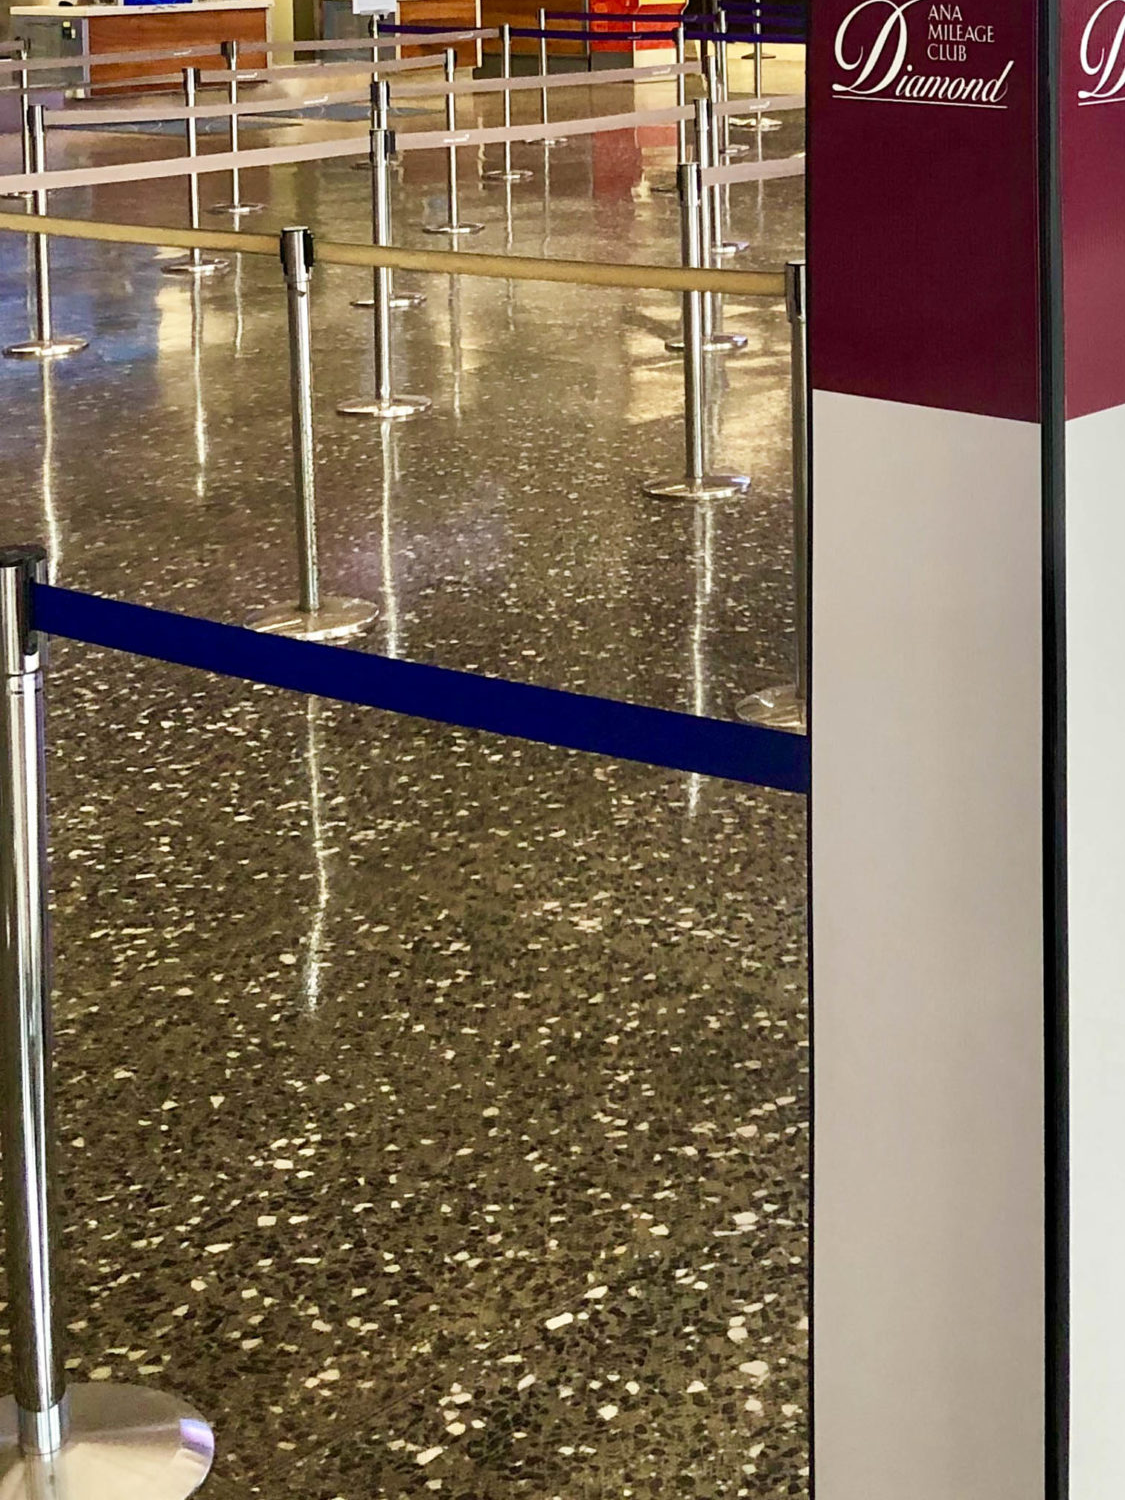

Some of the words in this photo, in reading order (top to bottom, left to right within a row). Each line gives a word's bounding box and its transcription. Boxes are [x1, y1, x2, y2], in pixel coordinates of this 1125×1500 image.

[927, 3, 963, 22] ANA
[928, 23, 995, 44] MILEAGE
[927, 42, 967, 63] CLUB
